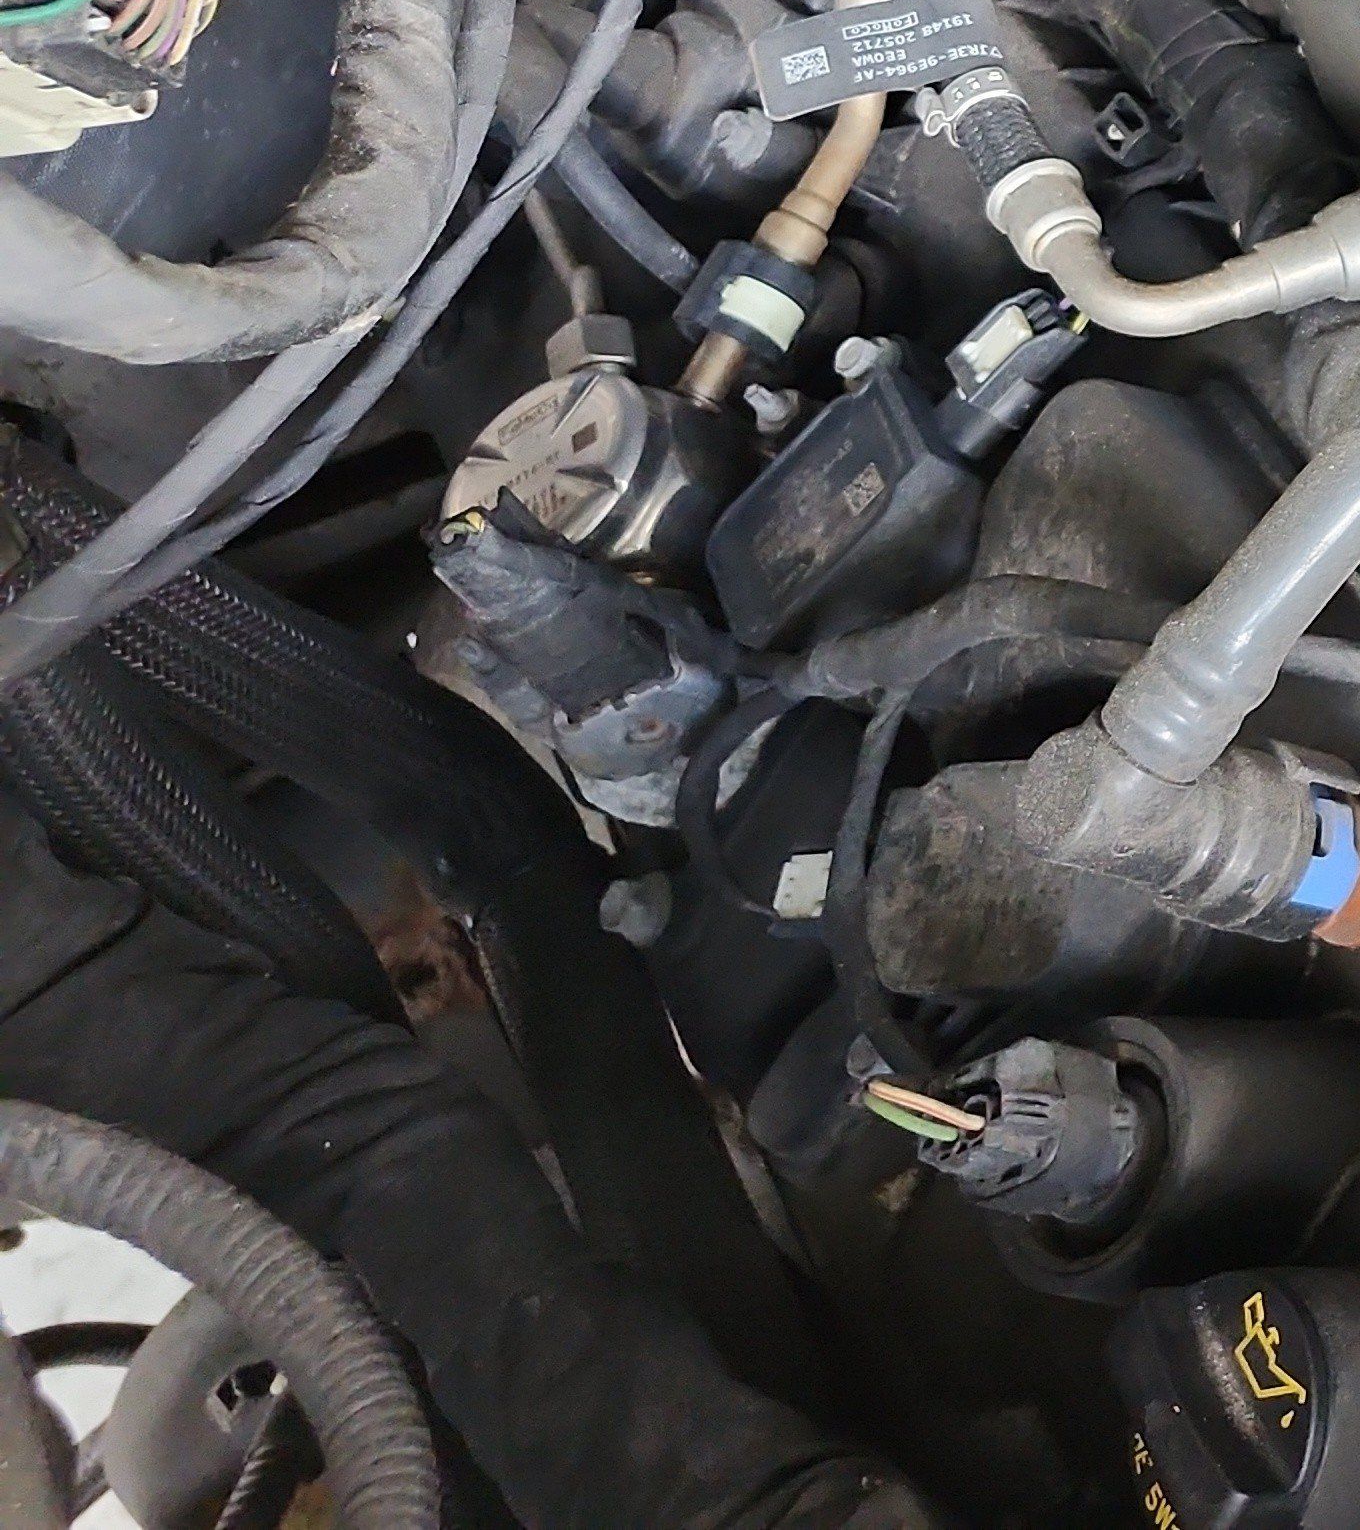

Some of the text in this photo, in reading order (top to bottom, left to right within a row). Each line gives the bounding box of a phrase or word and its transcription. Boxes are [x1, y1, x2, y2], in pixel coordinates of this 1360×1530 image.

[849, 15, 914, 34] FoMoCo
[852, 13, 974, 53] 19148 205712
